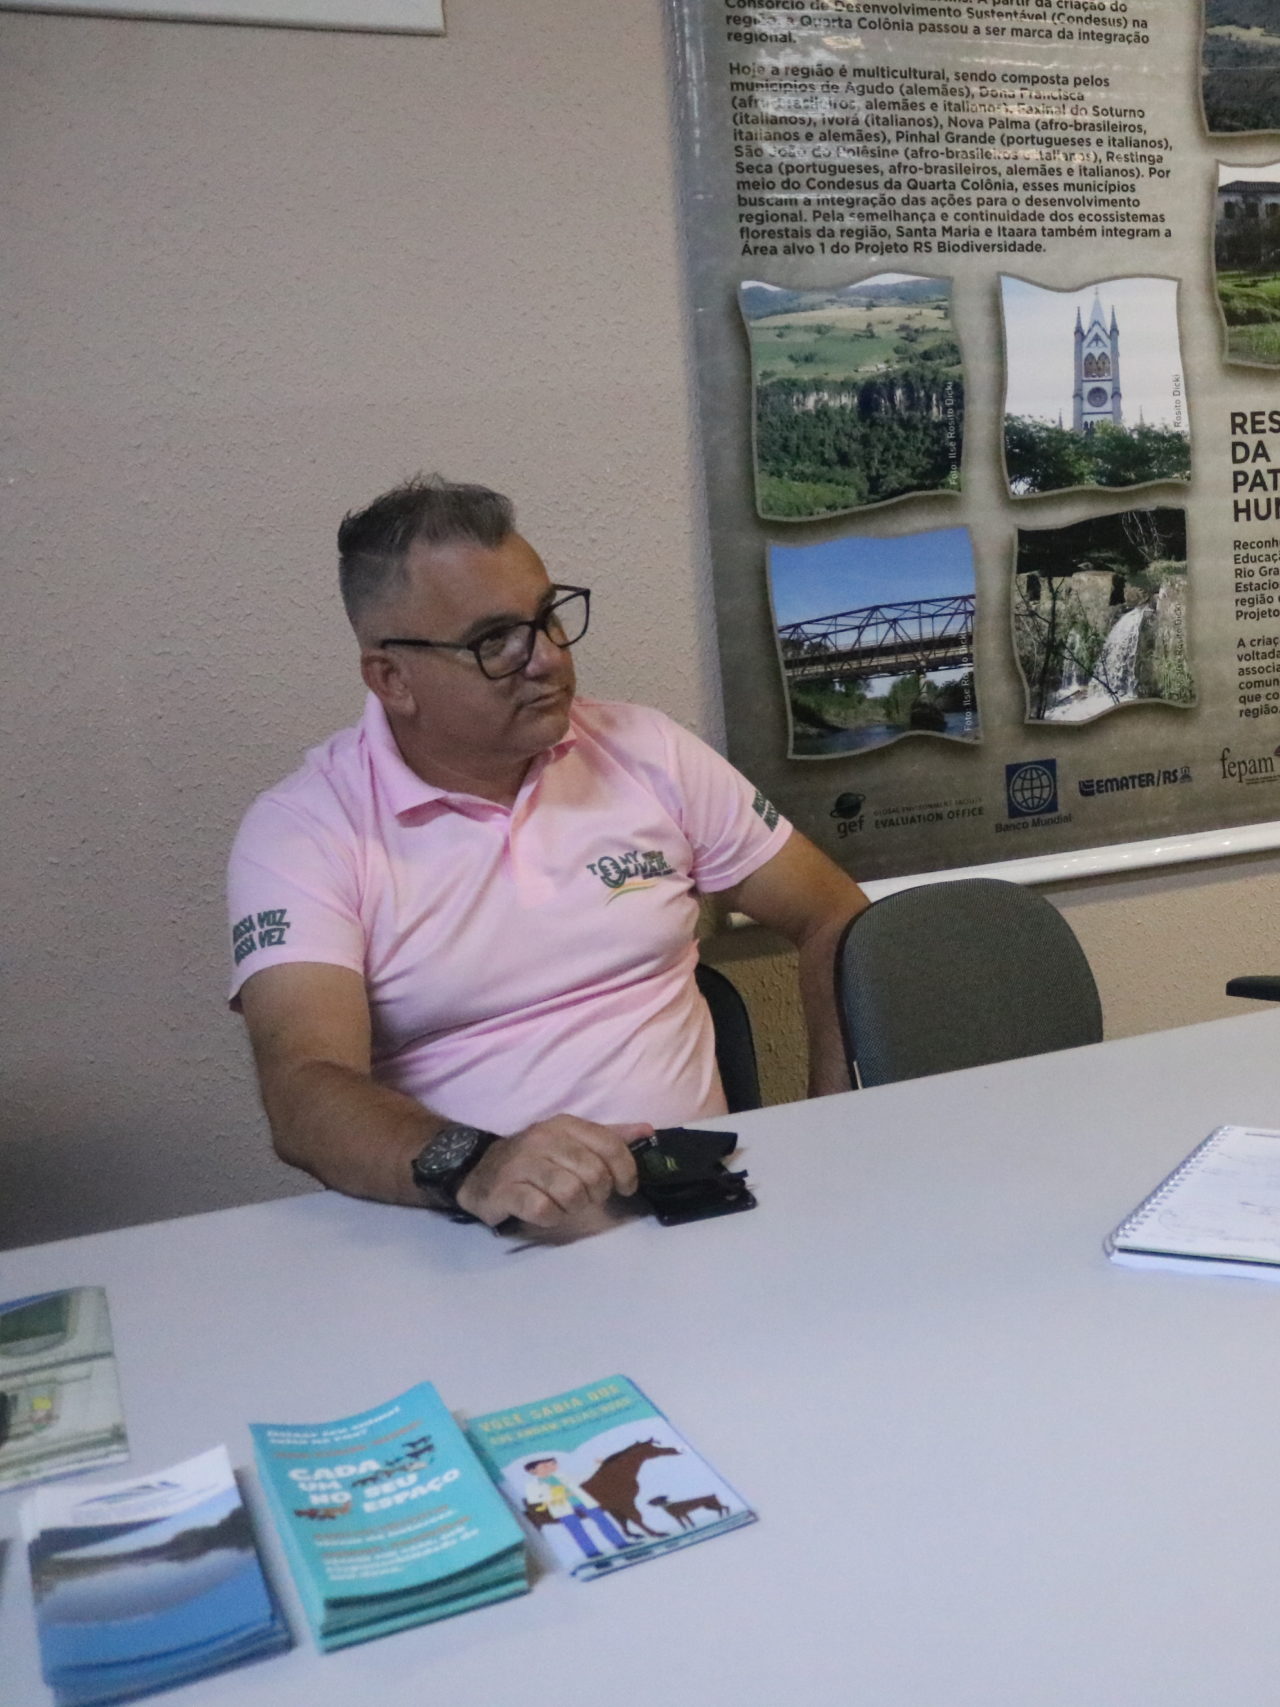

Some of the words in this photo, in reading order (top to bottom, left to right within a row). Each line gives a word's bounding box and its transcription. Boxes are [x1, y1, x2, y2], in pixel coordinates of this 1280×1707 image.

[737, 178, 775, 190] meio
[781, 178, 800, 190] do
[806, 178, 878, 190] Condesus
[884, 179, 901, 189] da
[907, 179, 955, 190] Quarta
[961, 179, 1017, 192] Colônia,
[1022, 182, 1058, 191] esses
[1063, 180, 1135, 194] municípios
[738, 210, 806, 225] regional.
[812, 210, 844, 221] Pela
[940, 212, 948, 221] e
[953, 210, 1044, 221] continuidade
[1049, 210, 1074, 221] dos
[1078, 210, 1165, 222] ecossistemas
[739, 226, 811, 239] florestais
[816, 226, 835, 238] da
[839, 228, 890, 240] região,
[896, 226, 936, 237] Santa
[941, 226, 979, 237] Maria
[984, 228, 992, 237] e
[997, 226, 1036, 237] Itaara
[1041, 225, 1096, 237] também
[1101, 225, 1160, 239] integram
[1164, 228, 1171, 237] a
[741, 242, 777, 255] Área
[782, 243, 814, 254] alvo
[819, 242, 824, 253] 1
[830, 242, 849, 253] do
[854, 242, 908, 255] Projeto
[913, 241, 932, 252] RS
[937, 240, 1045, 252] Biodiversidade.
[945, 382, 953, 405] Dicki
[1172, 375, 1180, 396] Dicki
[947, 409, 955, 438] Rosito
[1231, 439, 1269, 463] DA
[1234, 567, 1254, 578] Rio
[1235, 593, 1273, 607] região
[1235, 608, 1280, 621] Projeto
[1236, 638, 1246, 648] A
[1221, 748, 1274, 783] fepam
[837, 817, 864, 838] gef
[875, 813, 943, 829] EVALUATION
[947, 807, 984, 820] OFFICE
[995, 822, 1029, 832] Banco
[1032, 814, 1072, 827] Mundial
[259, 928, 286, 948] VEZ
[288, 1460, 380, 1480] CADA
[364, 1474, 417, 1498] SEU
